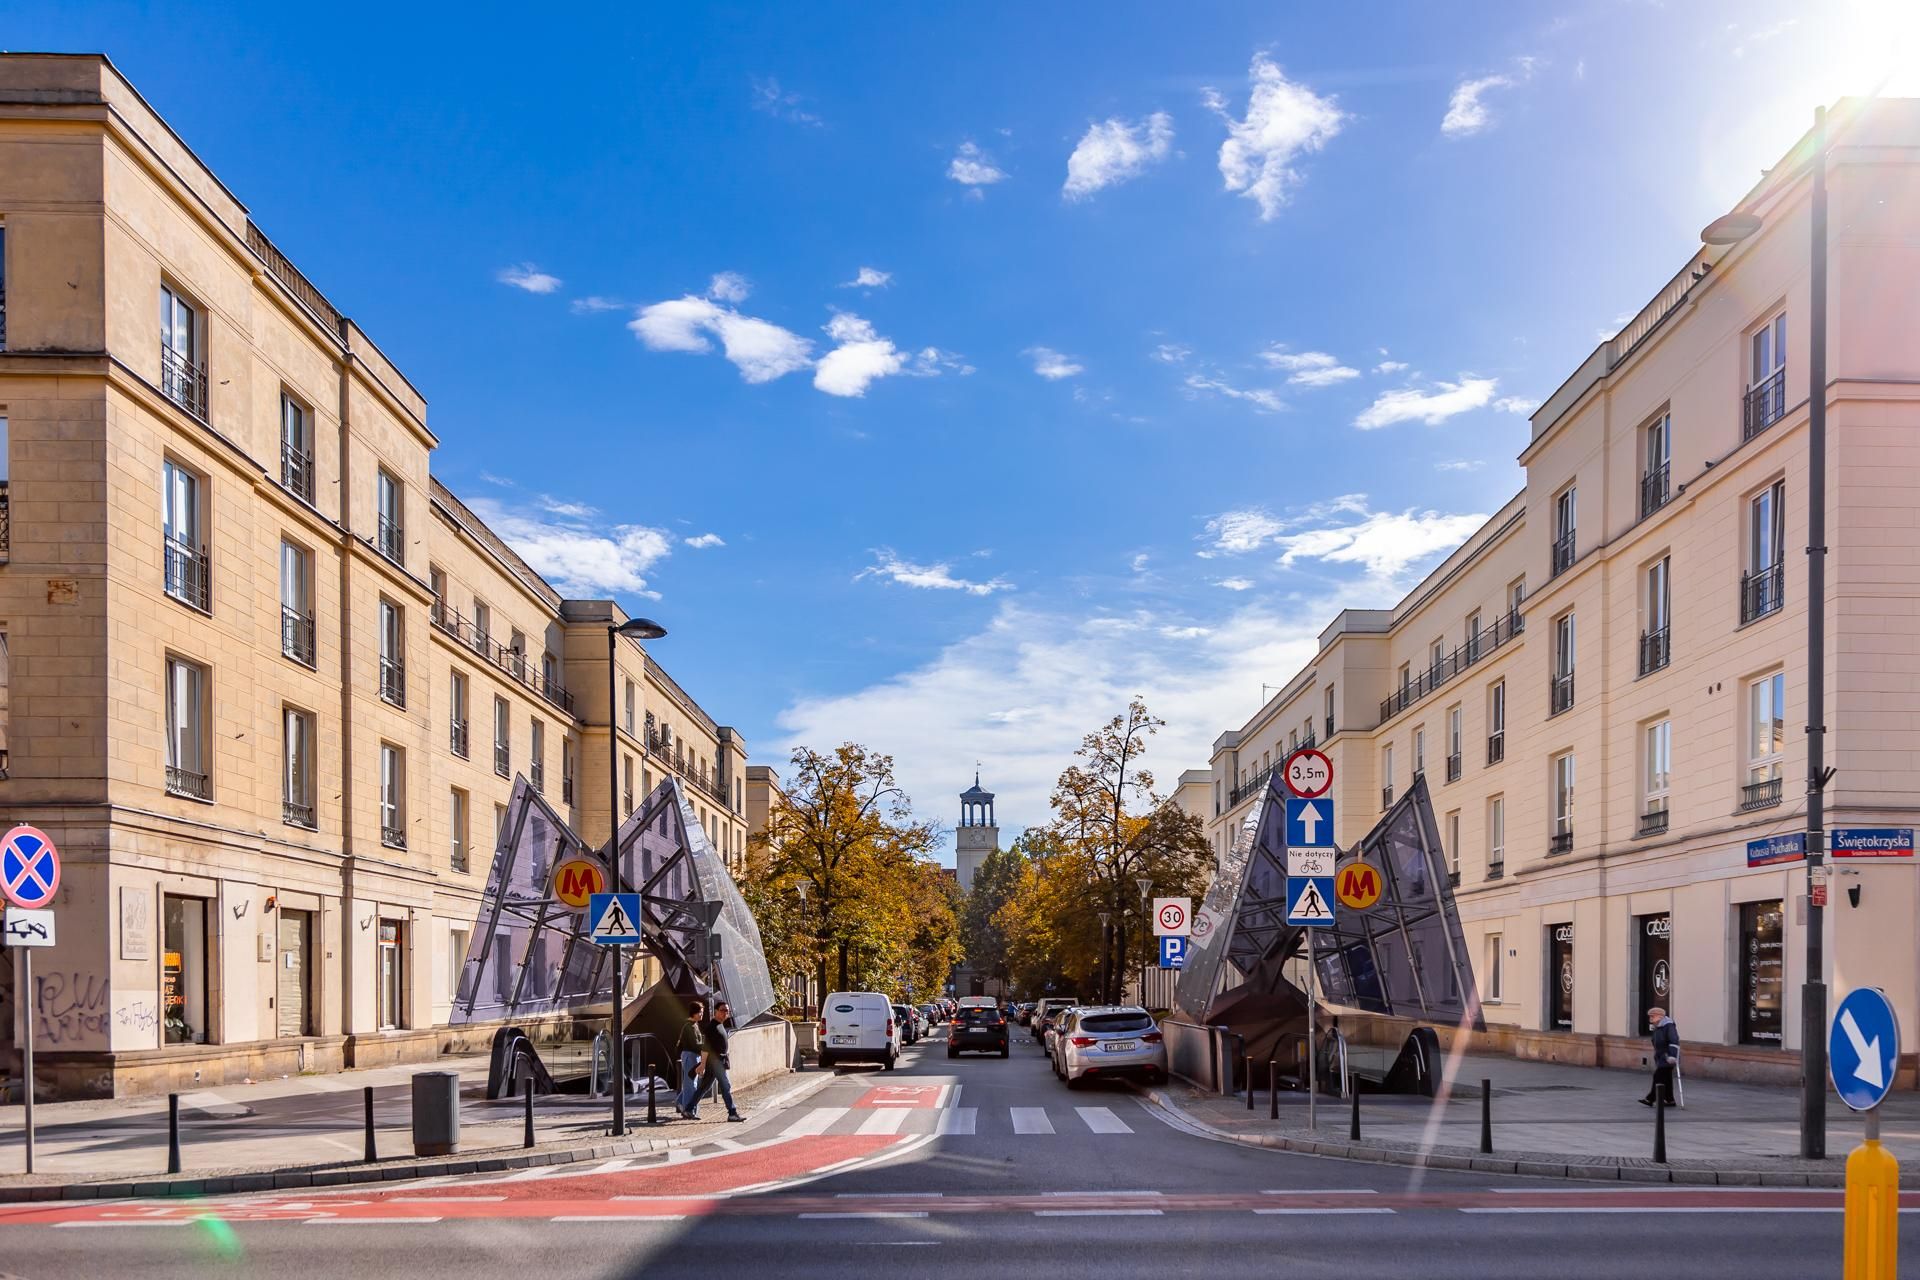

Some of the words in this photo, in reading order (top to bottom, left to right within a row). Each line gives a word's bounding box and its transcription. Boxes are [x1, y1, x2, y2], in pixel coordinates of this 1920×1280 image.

[1292, 766, 1325, 781] 3,5m
[1770, 840, 1799, 855] Puchatka
[1837, 835, 1910, 850] Świętokrzyska
[1305, 851, 1333, 859] dotyczy
[561, 868, 596, 898] M
[1342, 870, 1376, 900] M
[1163, 911, 1181, 923] 30
[1165, 938, 1180, 959] P
